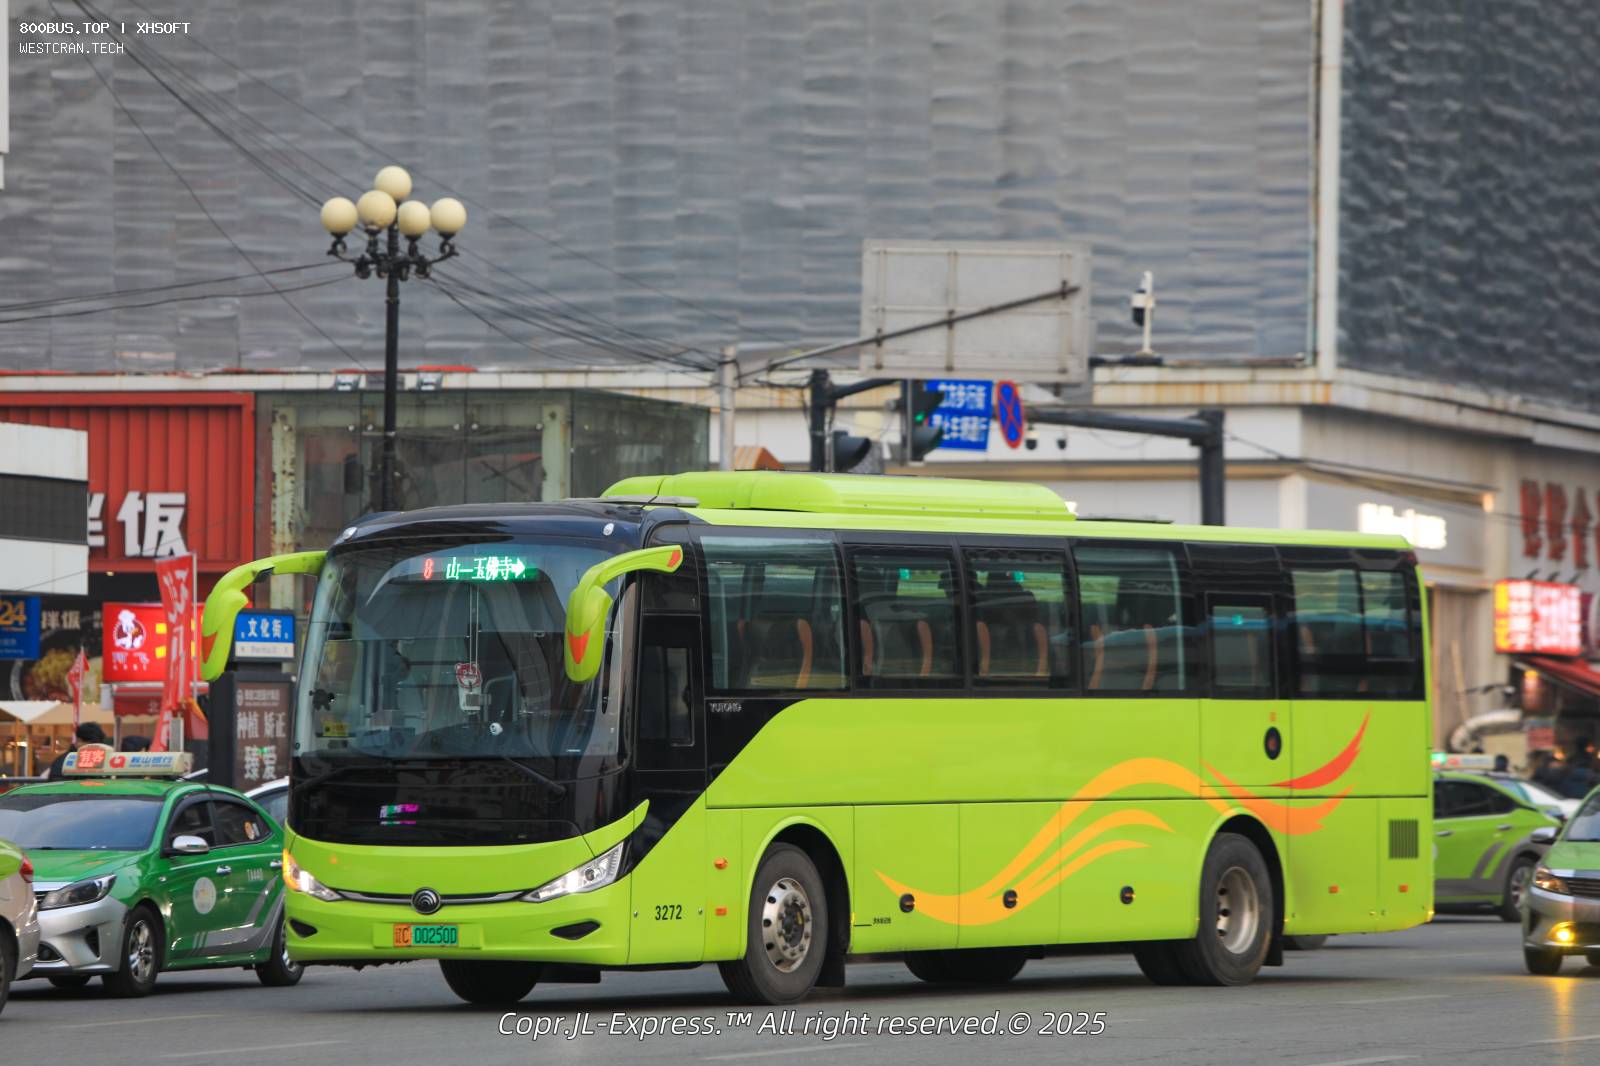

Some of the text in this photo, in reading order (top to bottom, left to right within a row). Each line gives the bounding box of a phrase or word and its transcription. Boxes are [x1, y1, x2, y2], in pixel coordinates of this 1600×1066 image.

[423, 558, 434, 580] 8
[248, 617, 282, 639] 文化街
[654, 904, 683, 921] 3272
